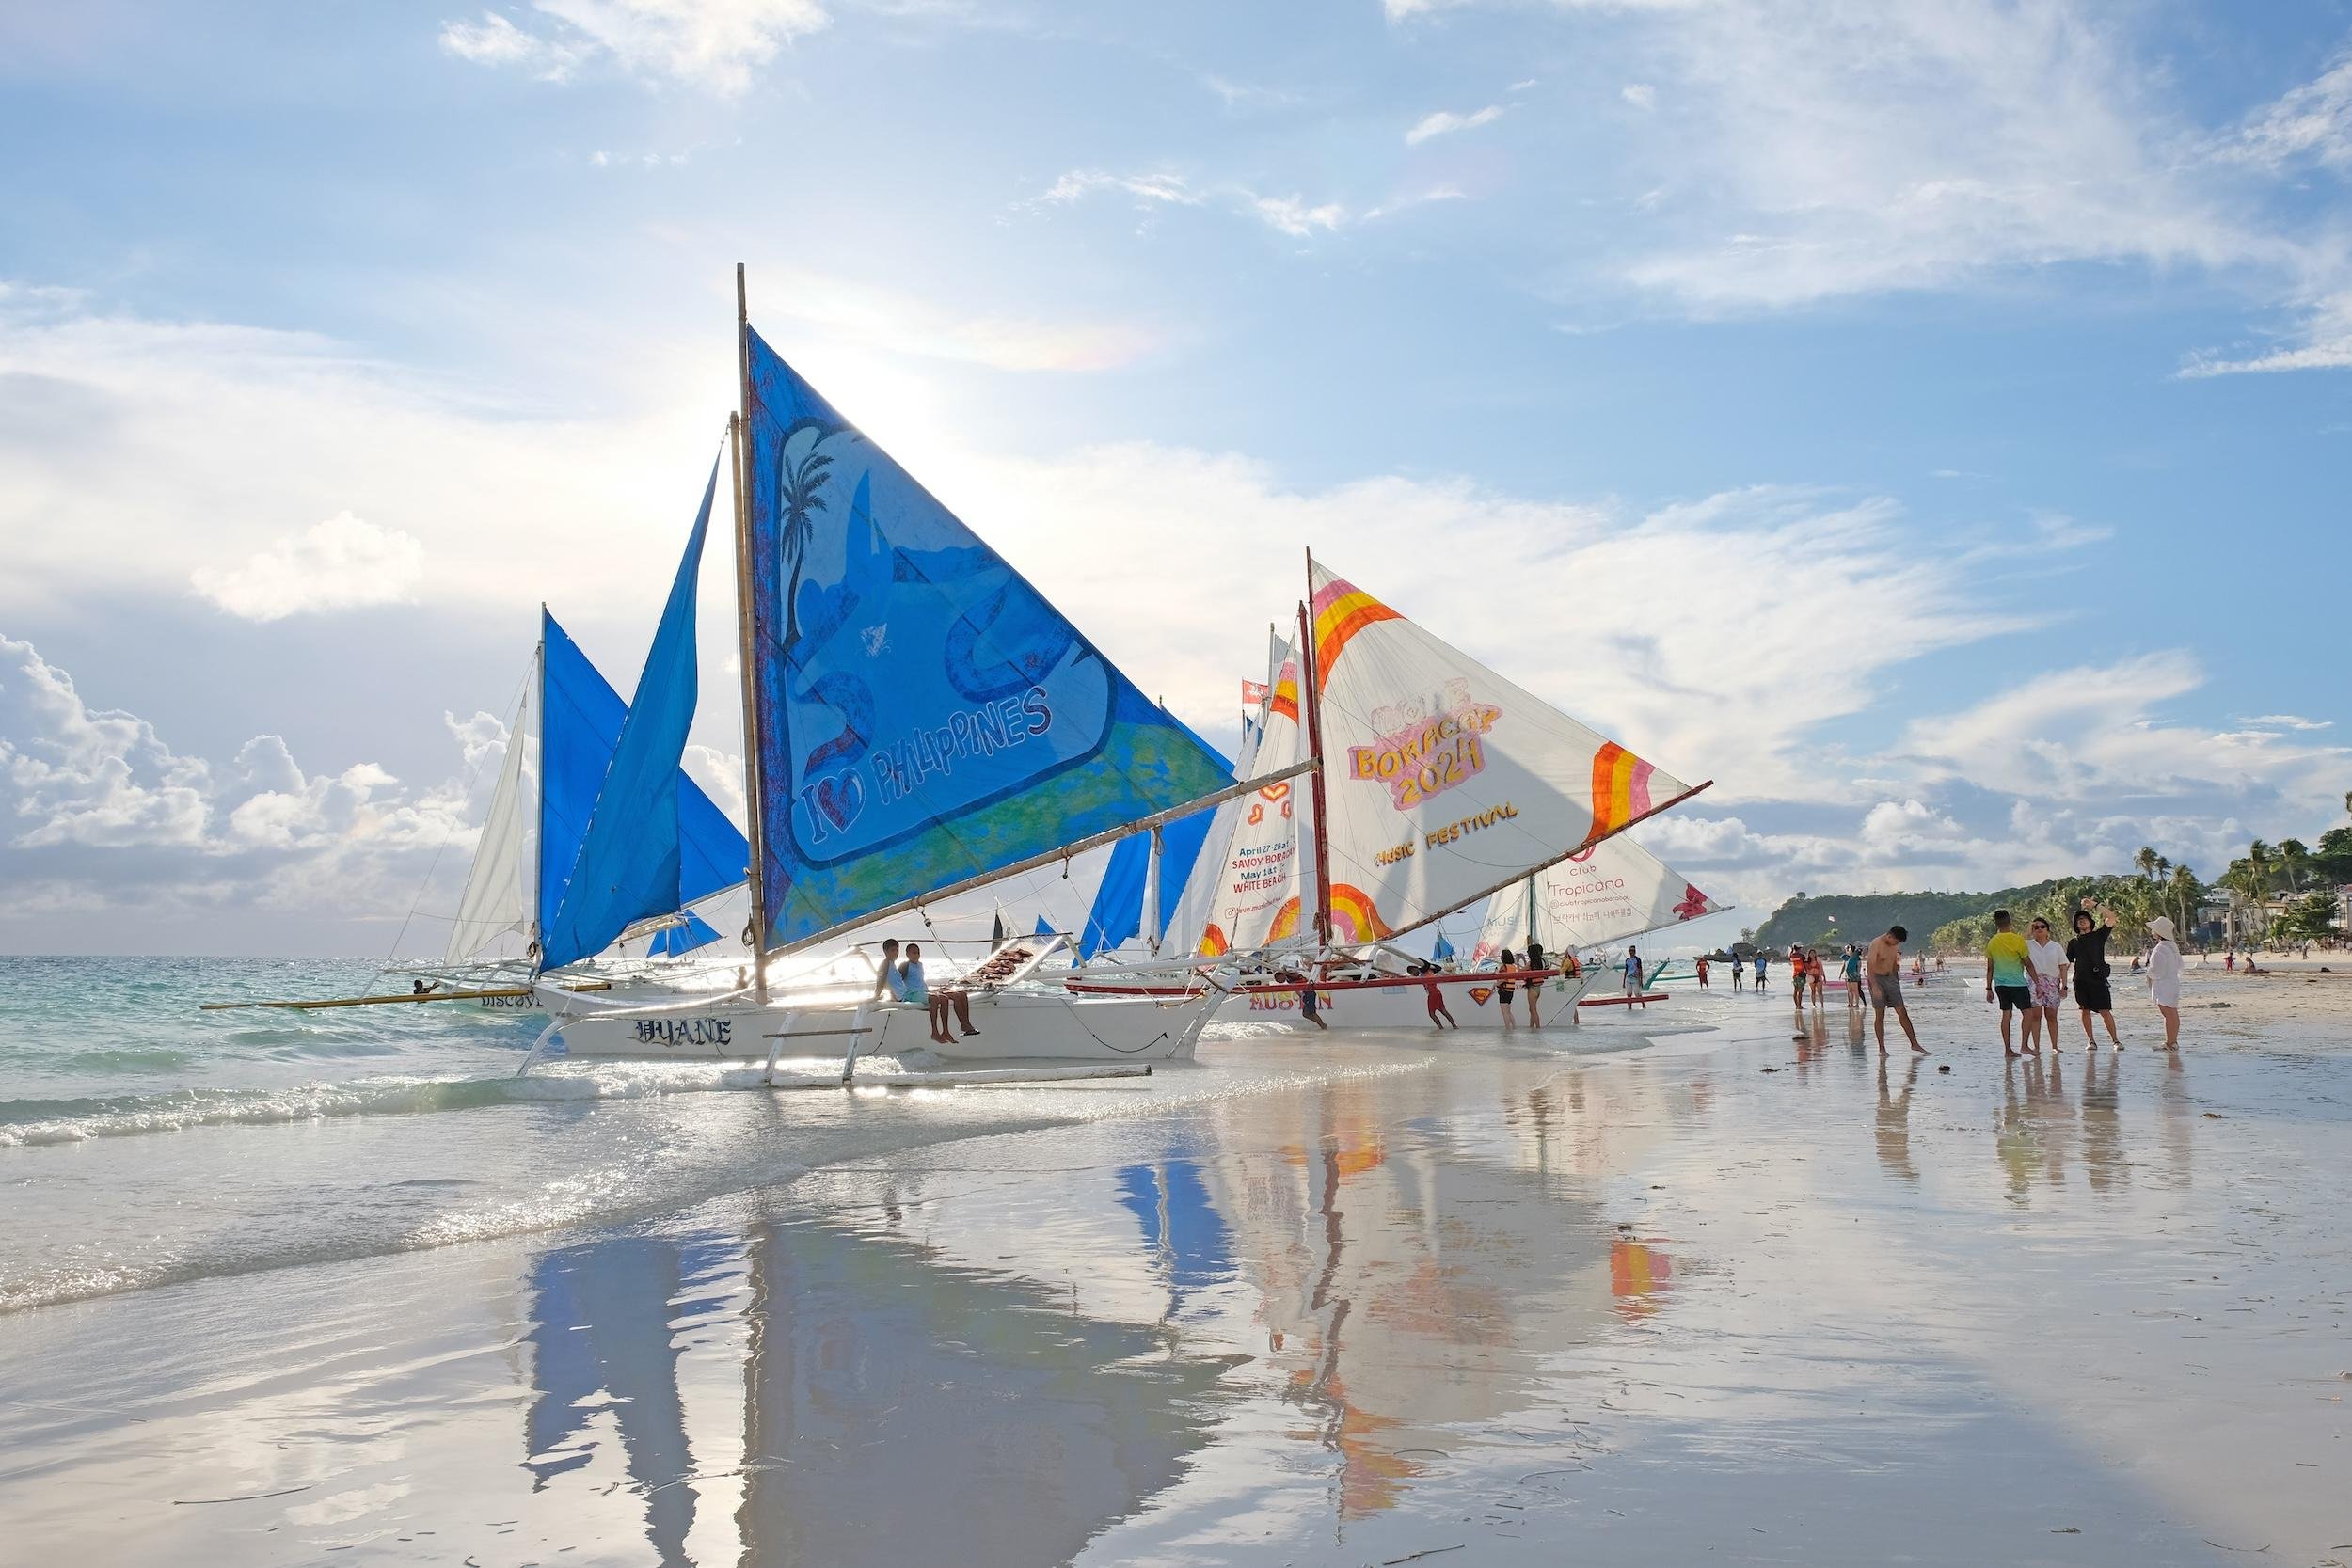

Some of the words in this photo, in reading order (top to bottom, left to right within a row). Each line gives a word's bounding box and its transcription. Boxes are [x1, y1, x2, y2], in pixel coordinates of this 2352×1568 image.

[1398, 737, 1481, 804] 2024
[1425, 801, 1519, 848] FESTIVAL
[1239, 847, 1262, 857] April
[1232, 858, 1263, 869] SAVOY
[1233, 879, 1262, 893] WHITE
[1263, 873, 1286, 889] BEACH
[1240, 871, 1262, 880] May
[1549, 877, 1624, 898] Tropicana
